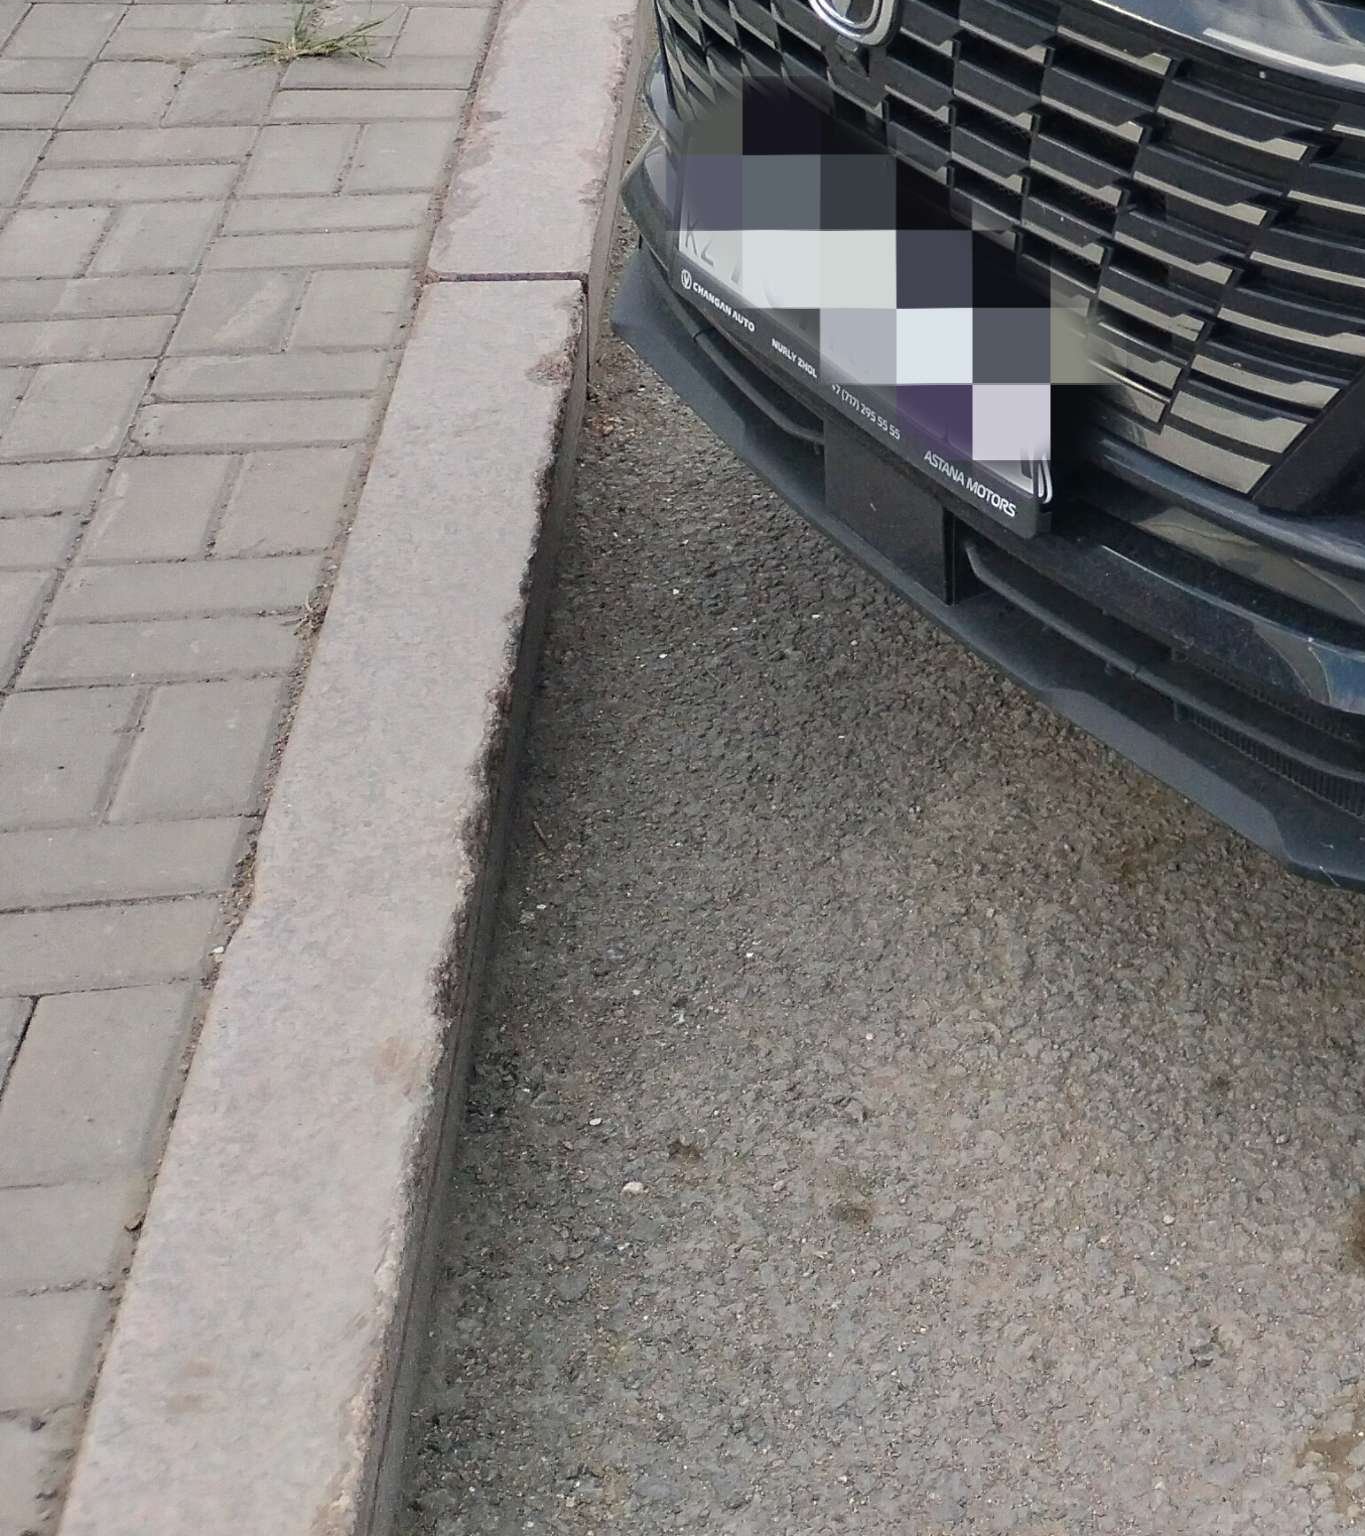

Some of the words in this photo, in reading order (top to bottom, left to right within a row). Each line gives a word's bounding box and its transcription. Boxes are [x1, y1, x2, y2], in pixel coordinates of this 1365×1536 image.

[692, 281, 732, 317] CHANGAN
[731, 310, 756, 333] AUTO
[771, 337, 798, 363] NURLY
[797, 356, 818, 379] ZHOL
[860, 402, 876, 423] 295
[877, 415, 889, 432] 55
[888, 424, 901, 441] 55
[924, 450, 965, 487] ASTANA
[966, 477, 1017, 518] MOTORS
